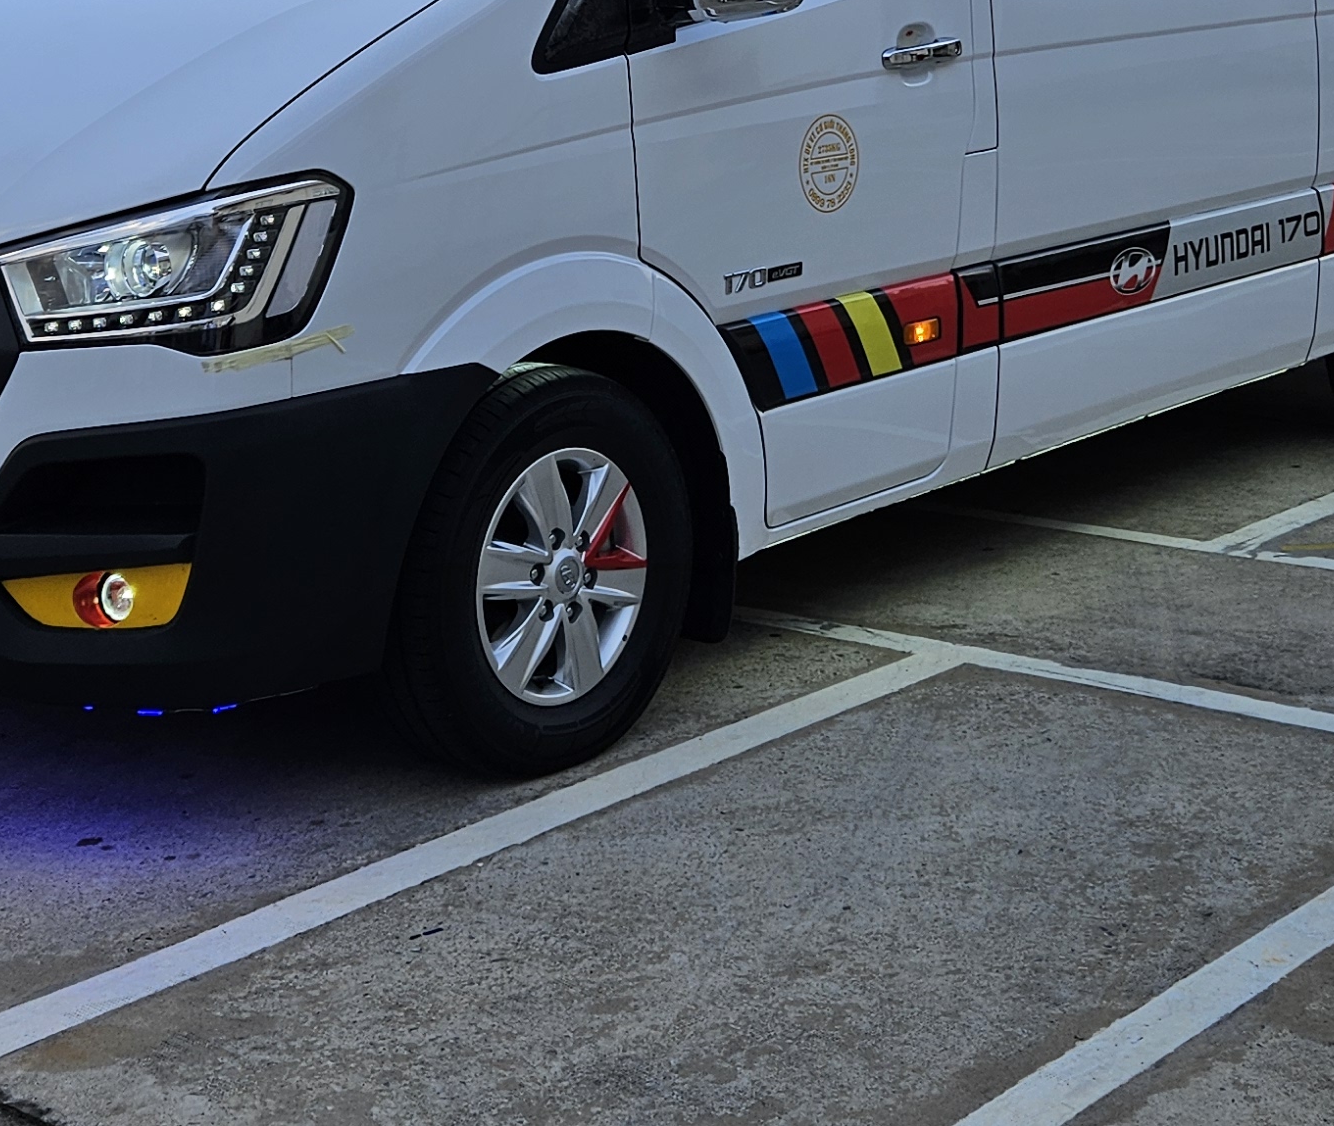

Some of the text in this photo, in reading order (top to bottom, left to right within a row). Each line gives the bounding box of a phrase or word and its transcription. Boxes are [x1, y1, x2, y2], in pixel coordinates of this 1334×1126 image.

[1174, 211, 1320, 276] HYUNDAI 170
[723, 266, 767, 295] 170
